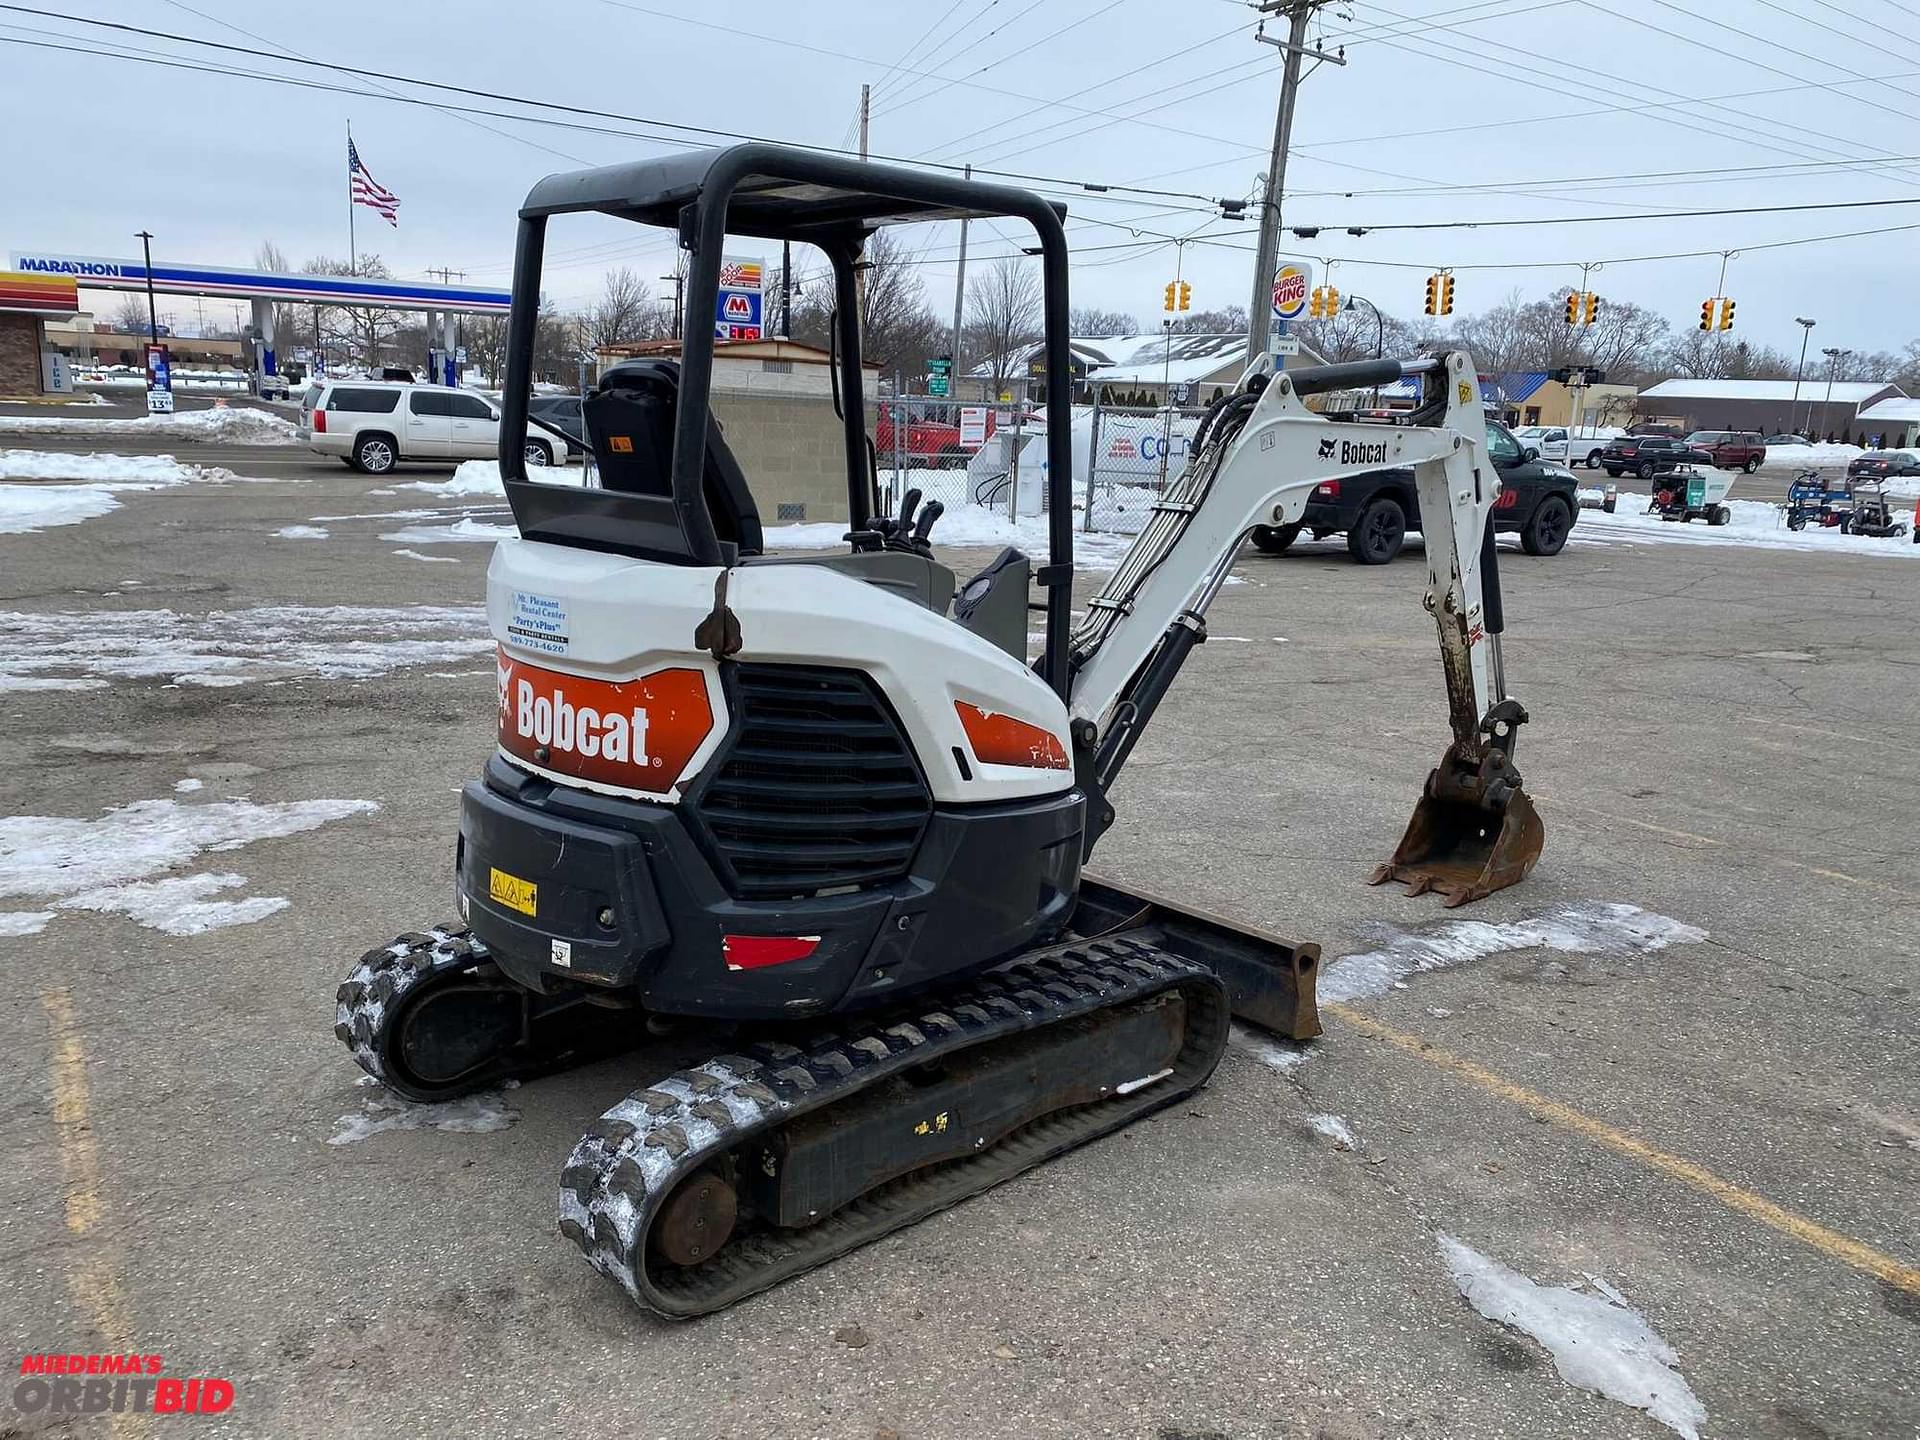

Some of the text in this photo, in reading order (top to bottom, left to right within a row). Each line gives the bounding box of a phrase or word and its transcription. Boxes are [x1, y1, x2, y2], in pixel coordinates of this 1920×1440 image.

[20, 258, 119, 276] MARATHON
[1273, 275, 1305, 292] BURGER
[1274, 285, 1306, 307] KING
[728, 298, 748, 312] M
[1341, 440, 1387, 464] Bobcat
[530, 596, 559, 608] Pleasant
[542, 608, 566, 619] Center
[518, 678, 649, 767] Bobcat
